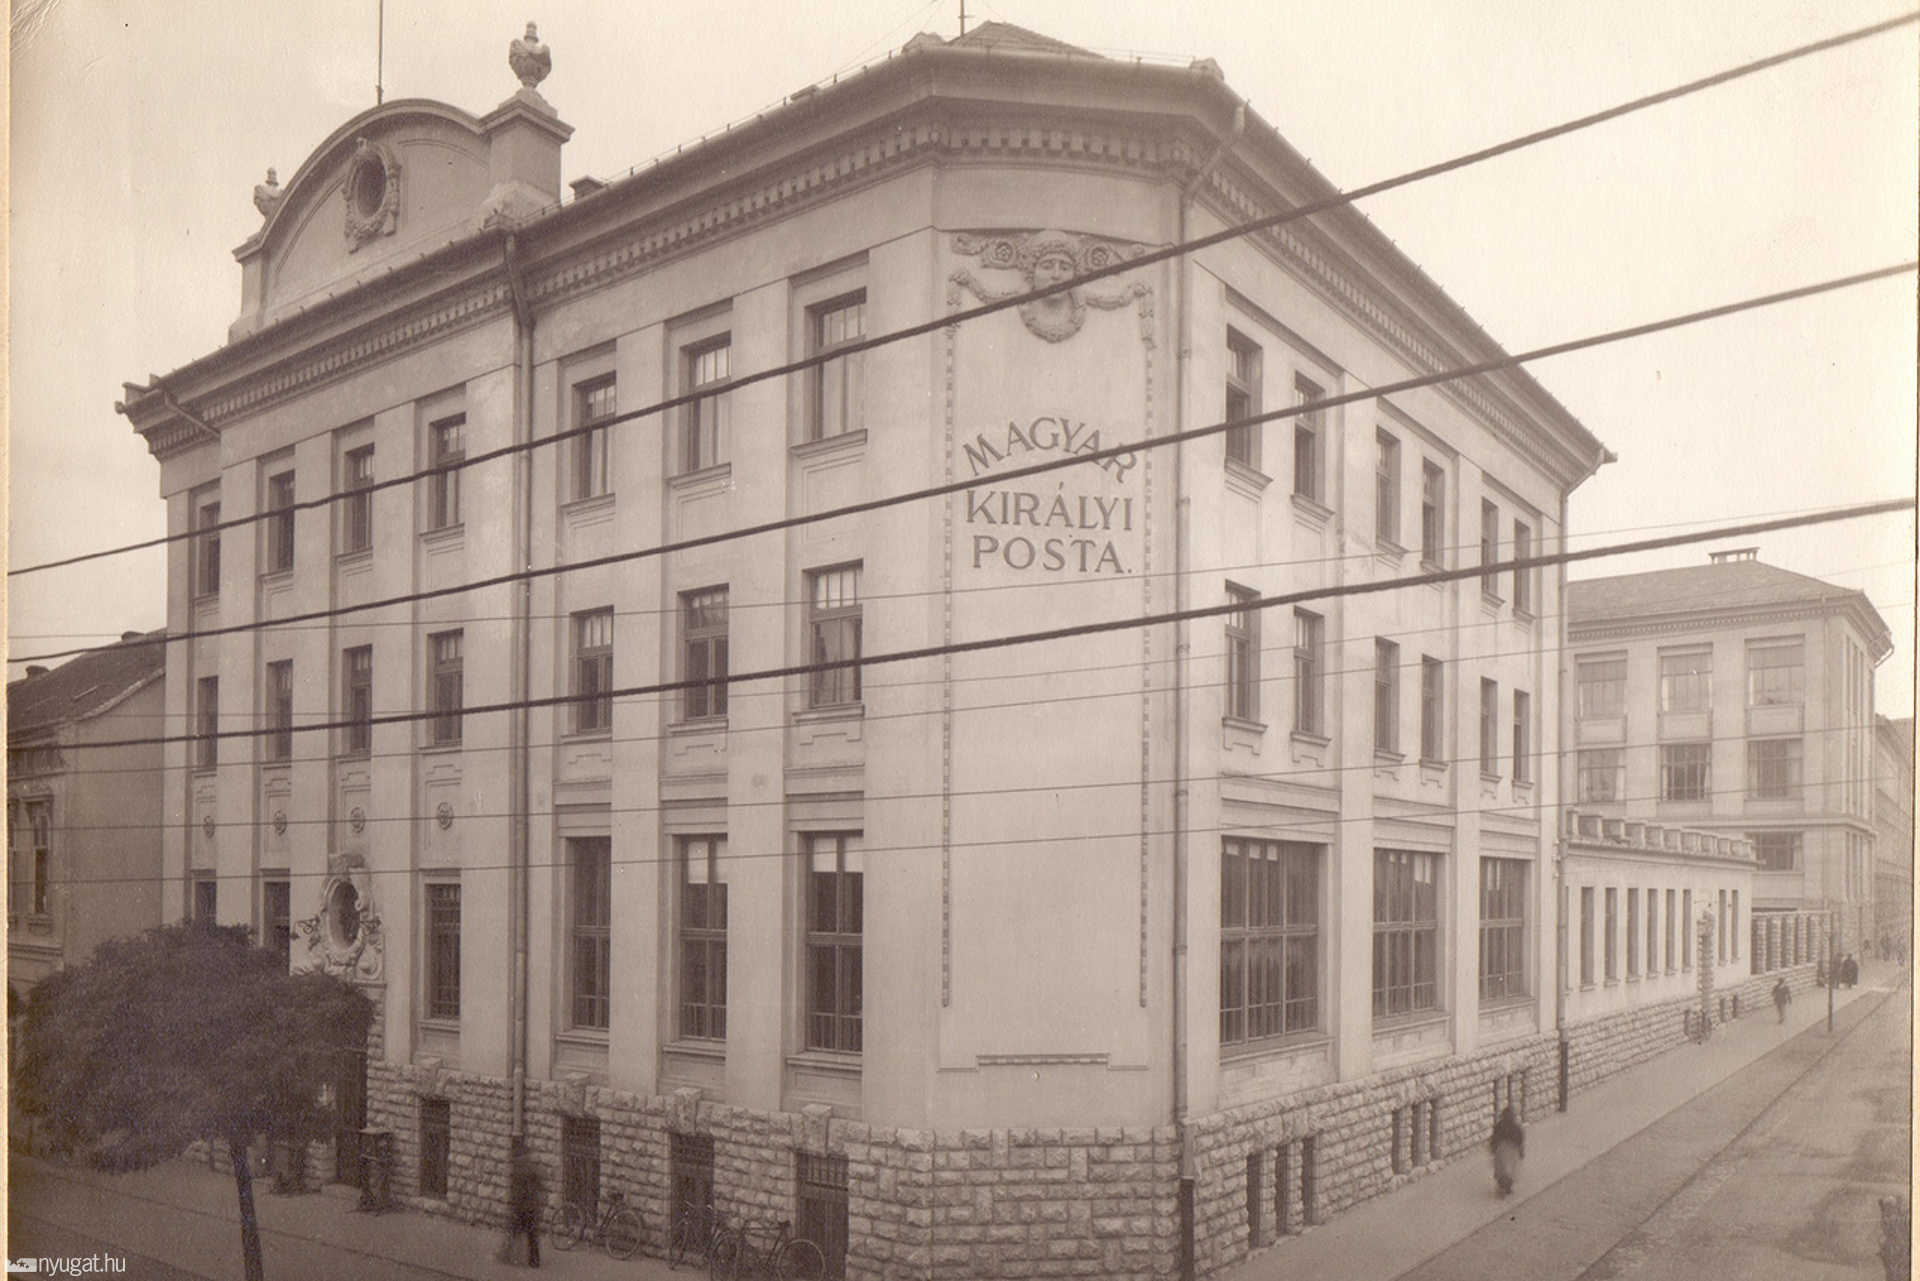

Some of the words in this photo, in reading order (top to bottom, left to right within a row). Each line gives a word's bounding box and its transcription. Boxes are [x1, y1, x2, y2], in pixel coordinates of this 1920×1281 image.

[962, 417, 1137, 483] MAGYAR
[966, 481, 1133, 531] KIRÁLYI
[973, 535, 1133, 574] POSTA.
